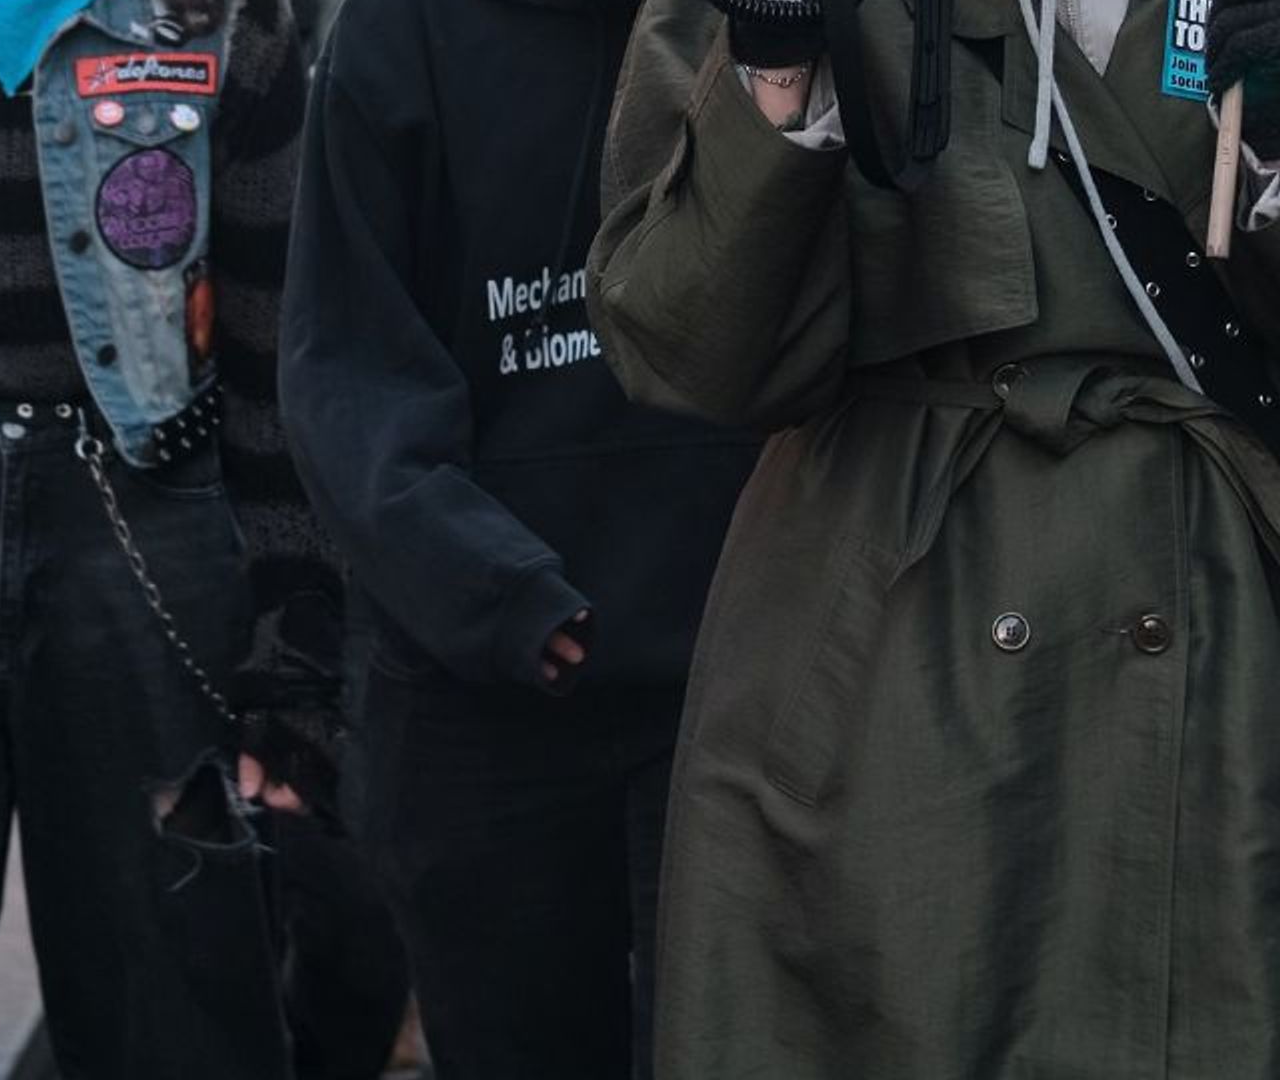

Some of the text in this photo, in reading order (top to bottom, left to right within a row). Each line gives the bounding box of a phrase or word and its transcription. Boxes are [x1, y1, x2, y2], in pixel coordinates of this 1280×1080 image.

[1171, 56, 1197, 73] Join
[487, 266, 586, 321] Mechan
[500, 334, 518, 375] &
